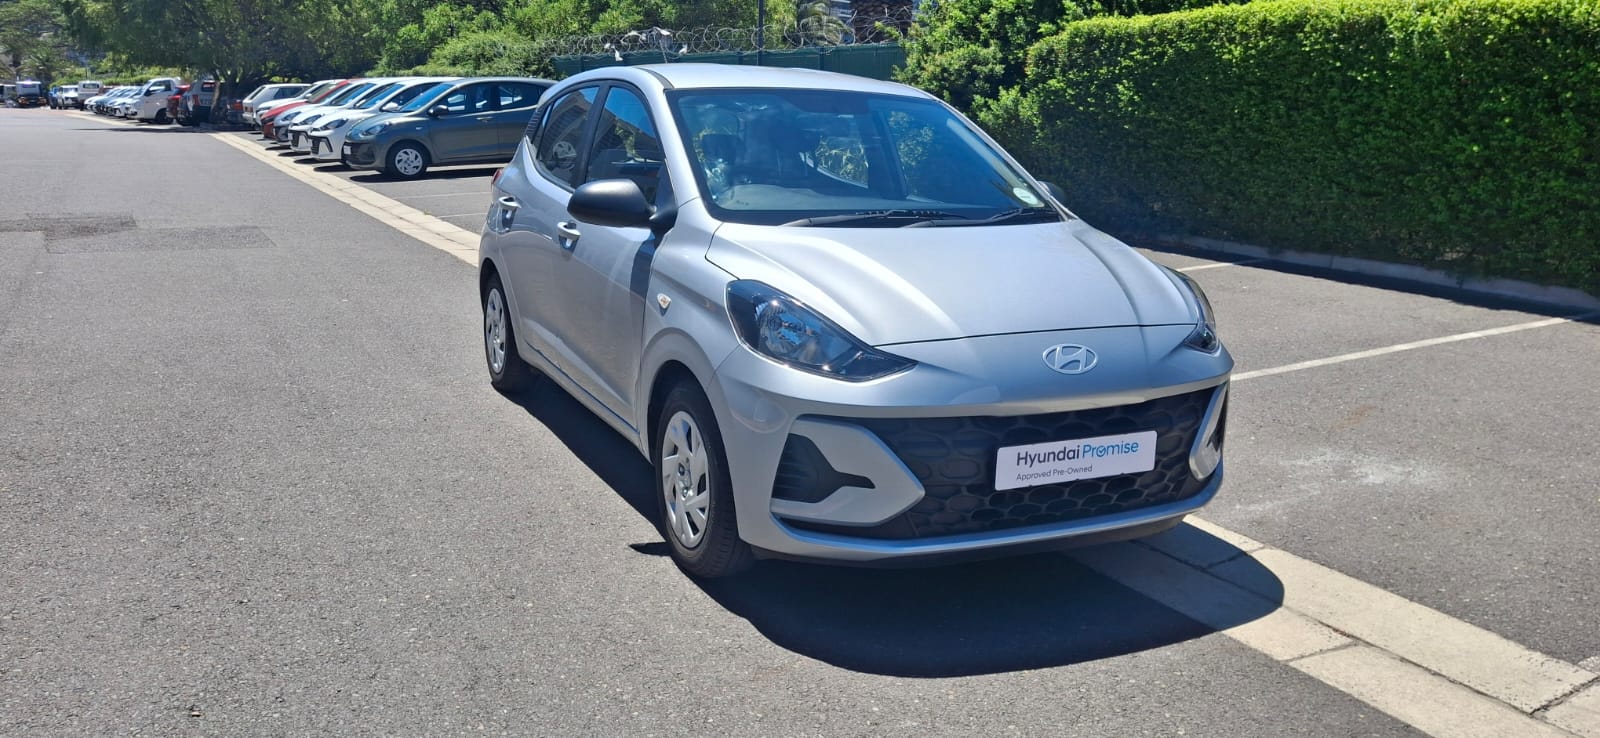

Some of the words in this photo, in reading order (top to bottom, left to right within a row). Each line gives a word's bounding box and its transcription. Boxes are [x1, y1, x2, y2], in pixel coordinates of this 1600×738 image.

[1016, 445, 1080, 468] Hyundai
[1082, 440, 1139, 458] Promise
[1016, 470, 1052, 481] Approved
[1052, 465, 1093, 476] Pre-Owned
